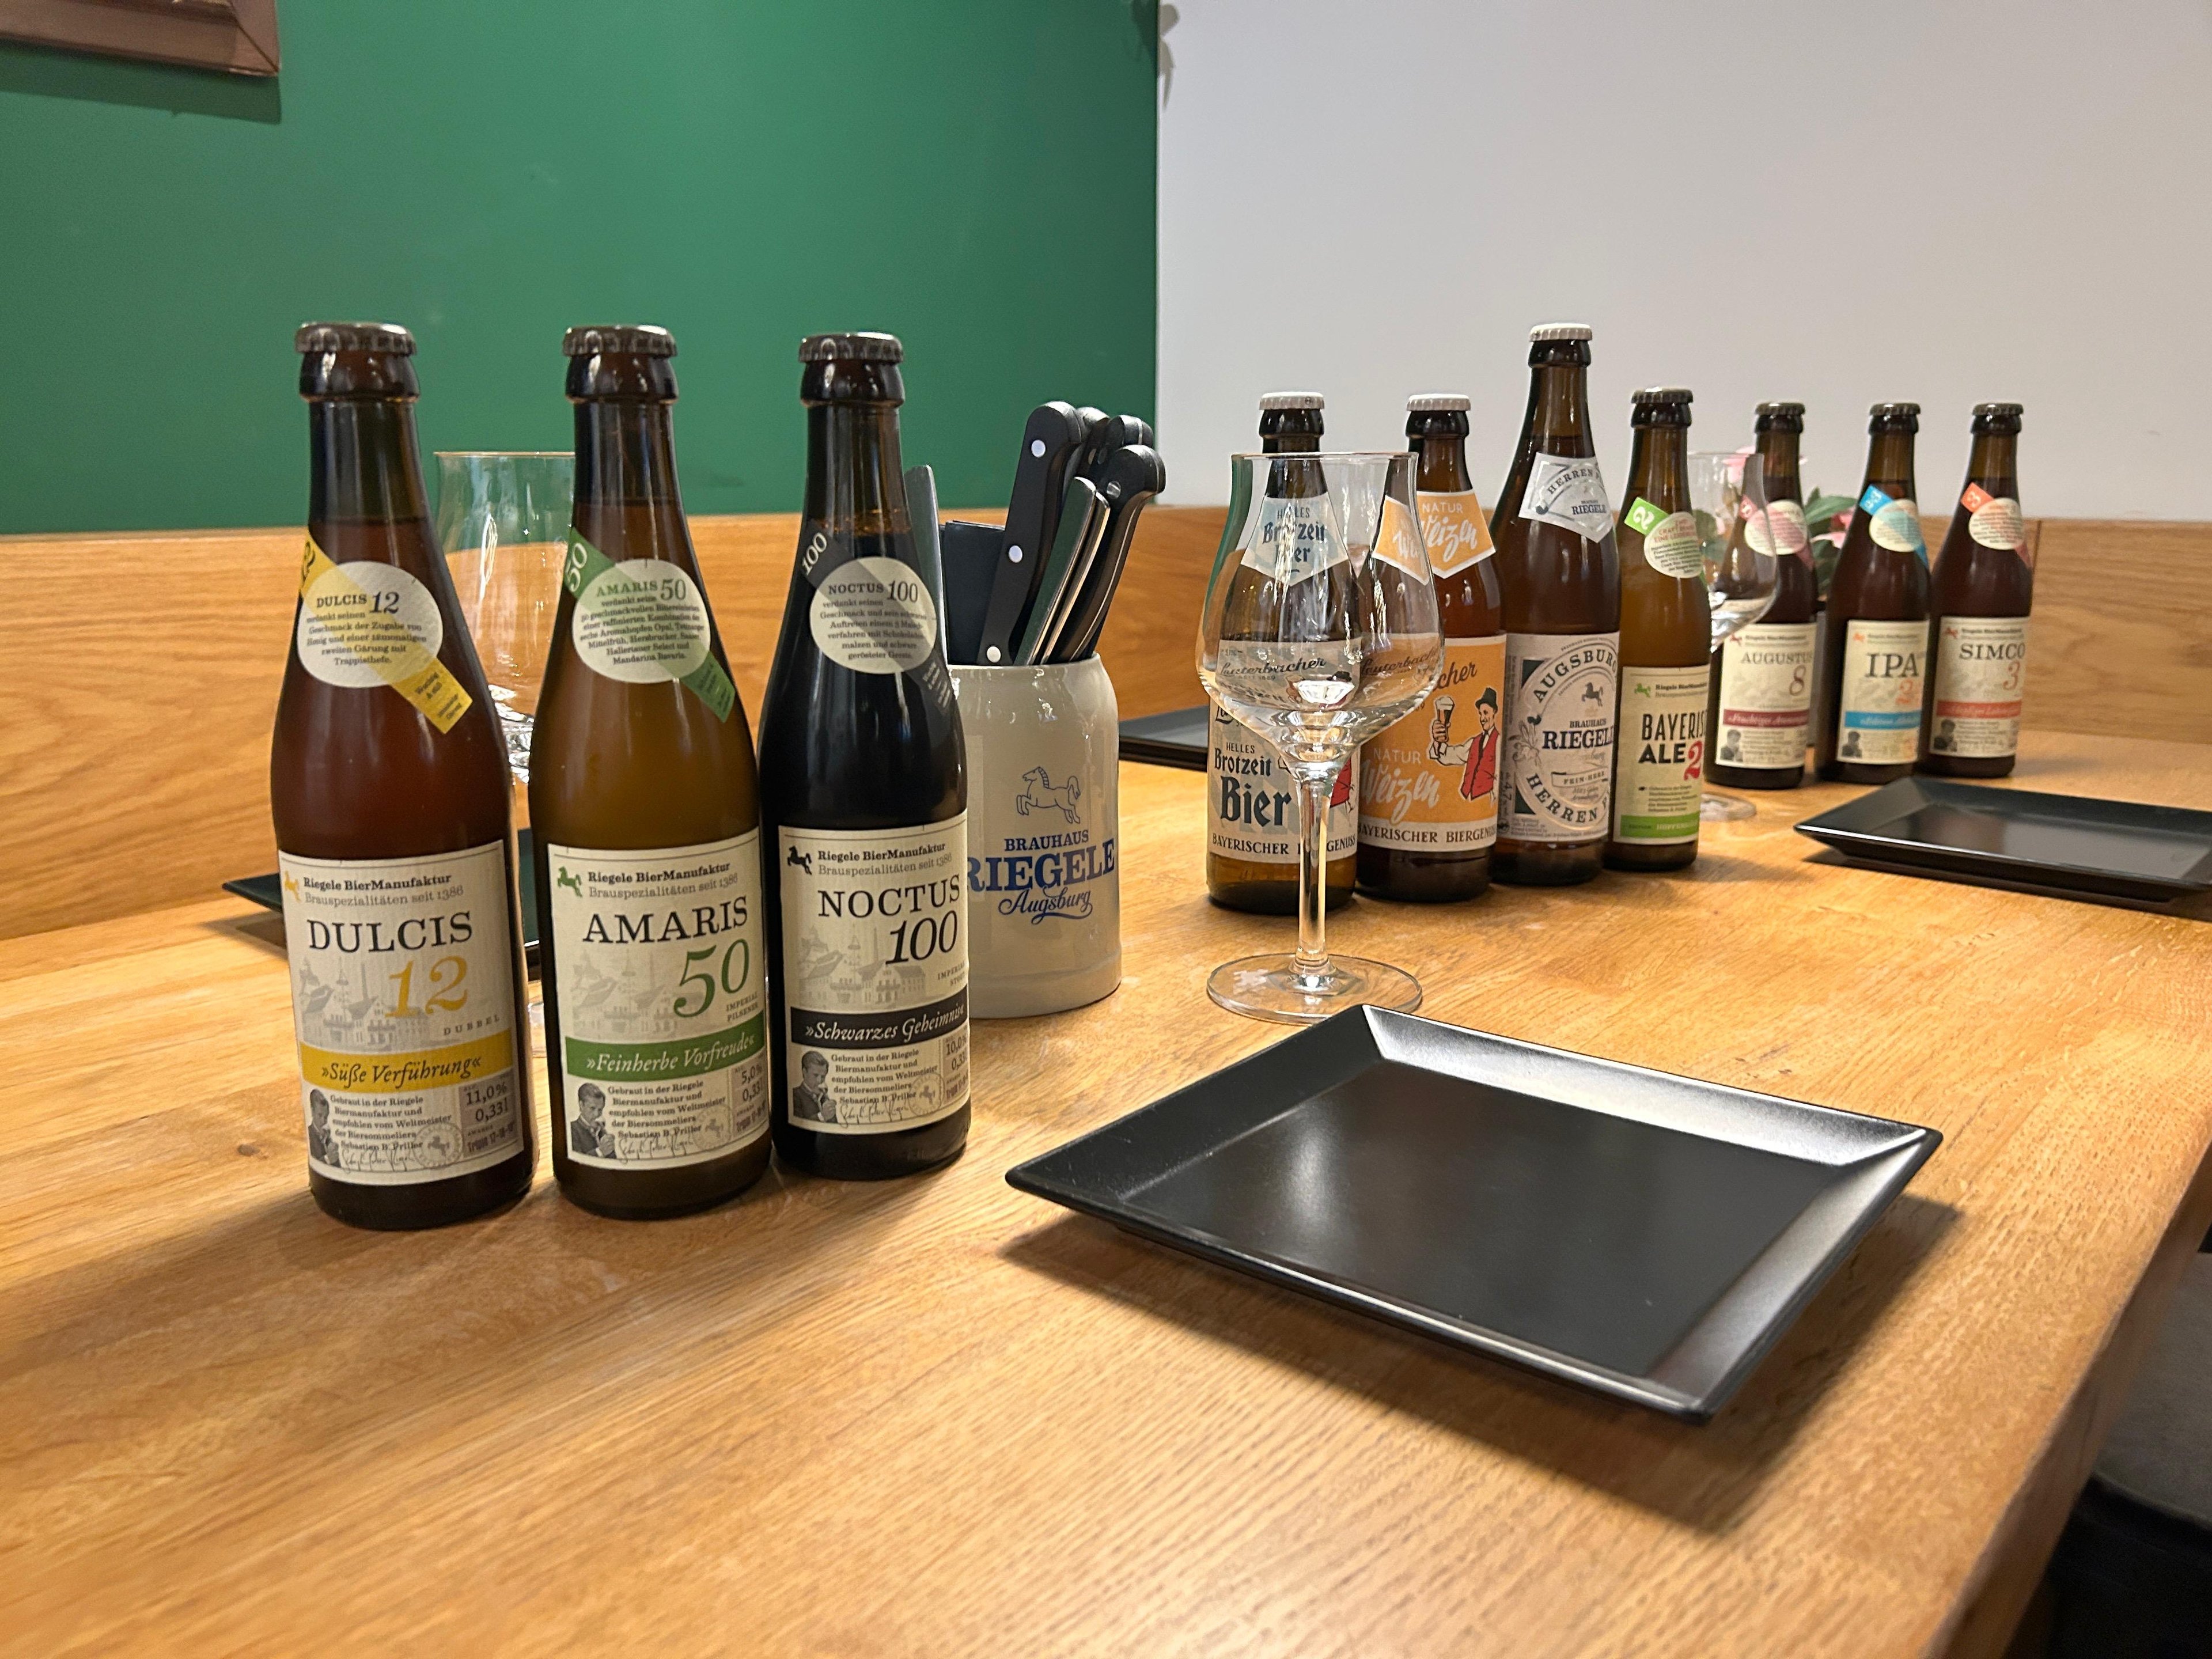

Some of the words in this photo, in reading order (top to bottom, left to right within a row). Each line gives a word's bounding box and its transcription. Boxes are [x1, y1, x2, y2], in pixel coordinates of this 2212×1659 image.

[1547, 468, 1594, 494] HERREN
[1422, 502, 1463, 514] NATUR
[1633, 506, 1655, 531] 2
[802, 532, 827, 575] 100
[565, 543, 588, 592] 50
[596, 580, 657, 597] AMARIS
[661, 578, 686, 600] 50
[828, 582, 884, 595] NOCTUS
[887, 580, 918, 603] 100
[317, 594, 367, 608] DULCIS
[369, 591, 399, 614] 12
[590, 605, 654, 620] geschmackvollen
[601, 597, 635, 607] verdankt
[823, 599, 857, 607] verdankt
[584, 622, 600, 630] einer
[603, 616, 645, 626] raffinierten
[820, 611, 865, 619] Geschmack
[868, 609, 882, 618] und
[309, 623, 352, 634] Geschmack
[355, 621, 369, 630] der
[372, 622, 404, 631] Zugabe
[830, 621, 868, 629] Auftreten
[328, 634, 344, 642] und
[607, 645, 651, 656] Hallertauer
[677, 641, 690, 649] und
[842, 641, 872, 649] malzen
[873, 641, 888, 649] und
[321, 646, 352, 655] zweiten
[354, 644, 389, 653] Gärung
[391, 643, 406, 652] mit
[613, 653, 656, 665] Mandarina
[1960, 642, 2026, 661] SIMCO
[1533, 649, 1618, 702] AUGSBURG
[1865, 652, 1919, 678] IPA
[1789, 665, 1806, 696] 8
[2003, 661, 2020, 691] 3
[1570, 718, 1606, 728] BRAUHAUS
[1642, 710, 1706, 741] BAYERIS
[1226, 742, 1255, 754] HELLES
[1373, 748, 1422, 765] NATUR
[1215, 748, 1271, 777] Brotzeit
[1638, 743, 1686, 764] ALE
[1683, 740, 1703, 781] 2
[1220, 775, 1292, 827] Bier
[1361, 759, 1440, 827] Weizen
[1527, 773, 1597, 823] HERREN
[1005, 830, 1089, 851] BRAUHAUS
[1213, 833, 1289, 855] BAYERISCHER
[1446, 824, 1497, 843] BIERGENUS
[818, 850, 860, 863] Riegele
[862, 843, 946, 861] BierManufaktur
[588, 871, 633, 885] Riegele
[636, 863, 730, 883] BierManufaktur
[819, 863, 916, 877] Brauspezialitäten
[918, 859, 934, 870] seit
[935, 853, 952, 868] 1386
[967, 838, 1115, 892] RIEGELE
[304, 877, 342, 892] Riegele
[344, 874, 452, 891] BierManufaktur
[589, 885, 696, 900] Brauspezialitäten
[698, 881, 717, 892] seit
[719, 873, 738, 889] 1386
[305, 892, 408, 908] Brauspezialitäten
[412, 891, 434, 903] seit
[437, 885, 464, 902] 1386
[817, 874, 960, 918] NOCTUS
[998, 885, 1093, 925] Augsburg
[582, 896, 748, 944] AMARIS
[307, 911, 473, 953] DULCIS
[885, 910, 957, 965] 100
[385, 955, 468, 1018] 12
[673, 938, 749, 1018] 50
[726, 991, 758, 1012] IMPERIAL
[444, 1014, 501, 1036] DUBBEL
[806, 1021, 897, 1041] »Schwarzes
[586, 1051, 678, 1073] »Feinherbe
[683, 1032, 755, 1070] Vorfreude«
[831, 1054, 864, 1063] Gebraut
[866, 1054, 874, 1062] in
[876, 1052, 889, 1060] der
[891, 1049, 919, 1060] Riegele
[321, 1062, 367, 1088] »Süße
[372, 1056, 482, 1089] Verführung«
[831, 1075, 874, 1084] empfohlen
[876, 1074, 893, 1082] vom
[895, 1065, 938, 1080] Weltmeister
[835, 1063, 901, 1073] Biermanufaktur
[903, 1059, 918, 1068] und
[467, 1082, 507, 1105] 11,0%
[608, 1086, 643, 1094] Gebraut
[656, 1086, 671, 1094] der
[672, 1080, 704, 1092] Riegele
[612, 1095, 684, 1105] Biermanufaktur
[685, 1090, 702, 1100] und
[834, 1085, 847, 1093] der
[849, 1082, 912, 1093] Biersommeliers
[330, 1094, 361, 1106] Gebraut
[362, 1097, 370, 1106] in
[373, 1098, 387, 1107] der
[389, 1096, 423, 1107] Riegele
[475, 1097, 507, 1122] 0,33l
[609, 1109, 654, 1118] empfohlen
[656, 1108, 676, 1116] vom
[677, 1096, 726, 1113] Weltmeister
[839, 1096, 880, 1105] Sebastian
[332, 1118, 372, 1128] empfohlen
[396, 1114, 452, 1128] Weltmeister
[335, 1107, 402, 1118] Biermanufaktur
[404, 1107, 422, 1116] und
[611, 1119, 625, 1127] der
[627, 1115, 696, 1128] Biersommeliers
[335, 1128, 346, 1137] der
[348, 1130, 416, 1141] Biersommeliers
[618, 1130, 661, 1139] Sebastian
[341, 1140, 380, 1151] Sebastian
